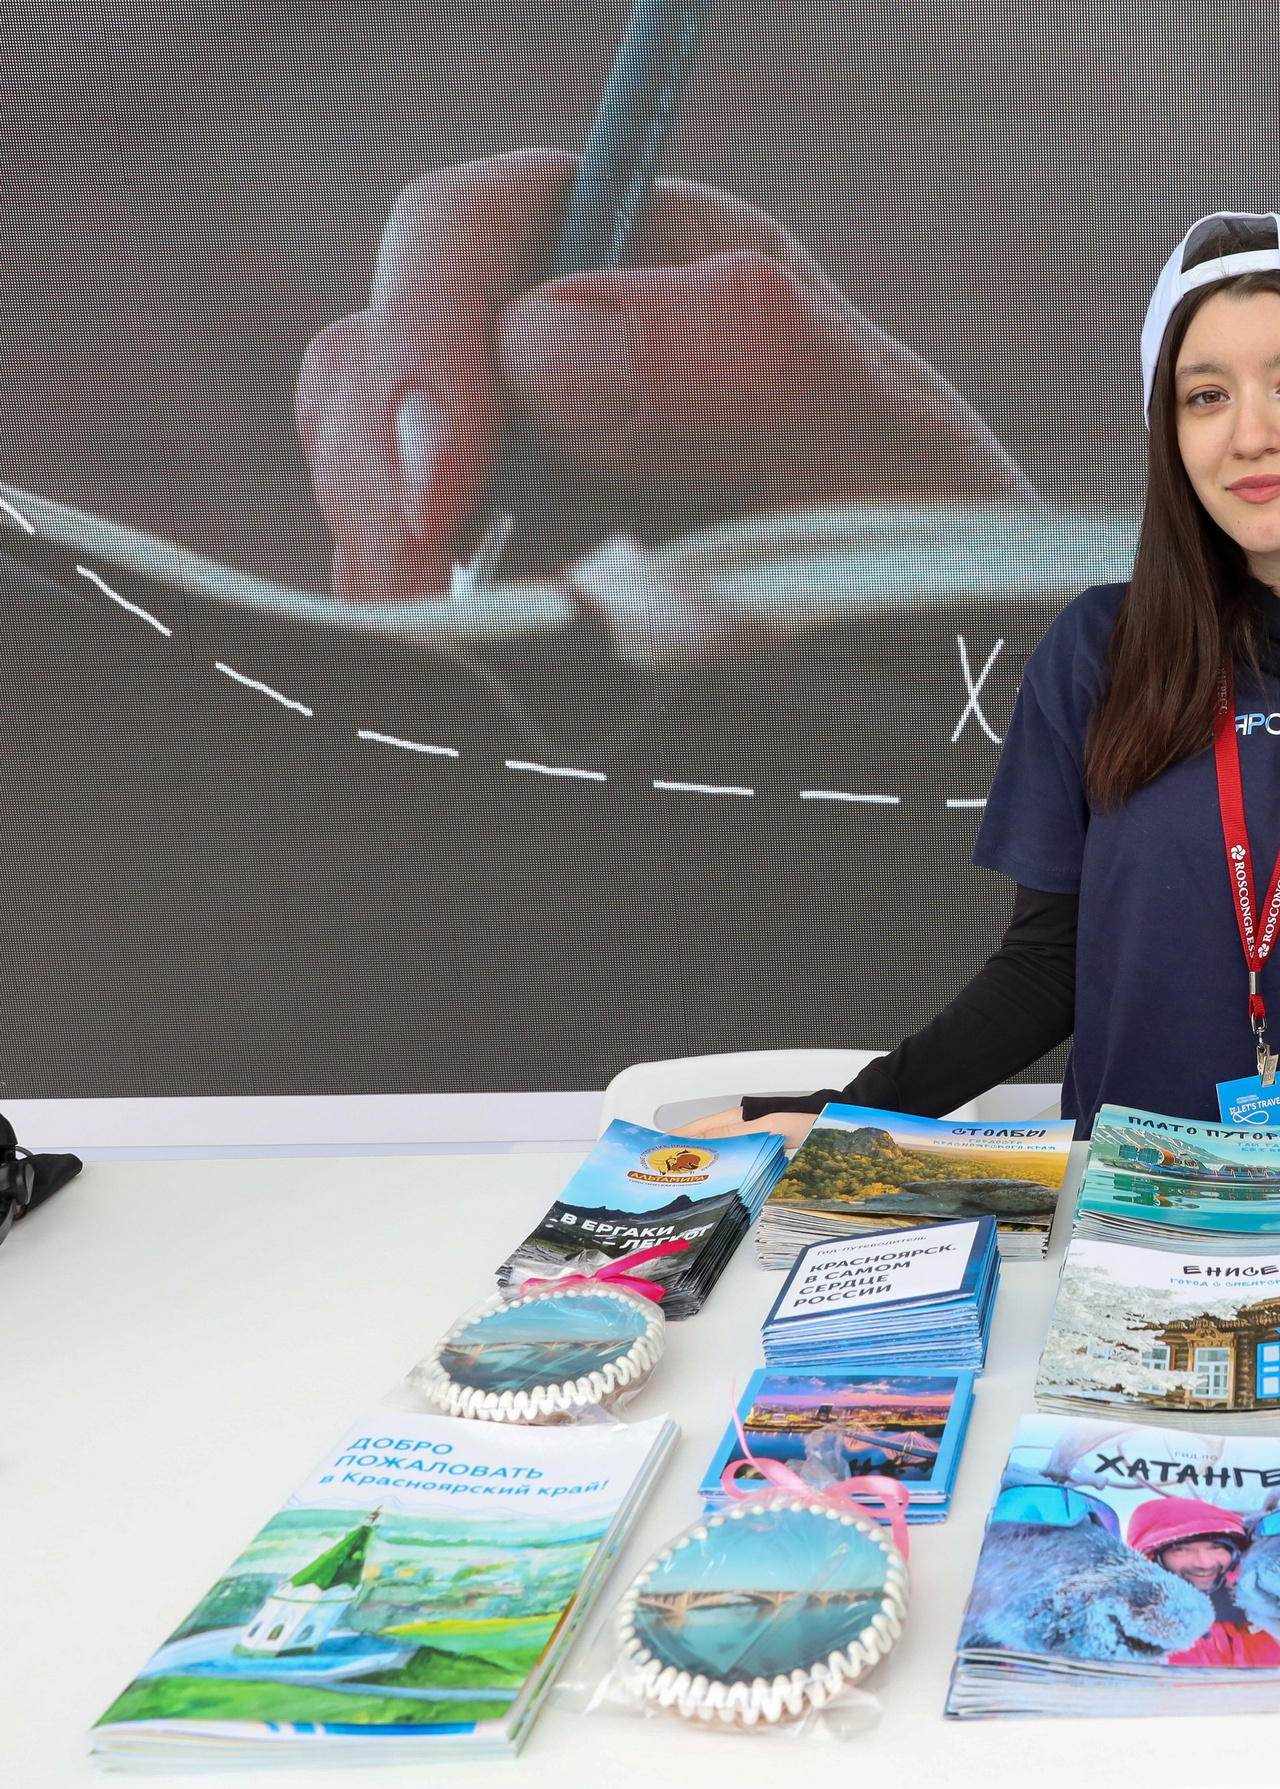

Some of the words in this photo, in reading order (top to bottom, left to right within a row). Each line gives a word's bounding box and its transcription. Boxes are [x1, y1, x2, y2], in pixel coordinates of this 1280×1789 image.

[1234, 861, 1255, 959] ROSCONGRESS
[951, 1128, 1047, 1138] СТОЛБЫ
[1128, 1116, 1198, 1135] ПЛАТО
[630, 1172, 706, 1183] АЛЬТАМИРА
[560, 1212, 578, 1225] В
[581, 1219, 676, 1237] ЕРГАКИ
[809, 1243, 957, 1273] КРАСНОЯРСК.
[804, 1275, 818, 1284] В
[824, 1261, 911, 1280] САМОМ
[1169, 1277, 1209, 1287] ГОРОД
[793, 1284, 892, 1308] РОССИИ
[799, 1274, 889, 1295] СЕРДЦЕ
[345, 1437, 453, 1455] ДОБРО
[334, 1454, 544, 1480] ПОЖАЛОВАТЬ
[319, 1474, 335, 1484] в
[340, 1471, 530, 1496] Красноярский
[537, 1479, 610, 1498] край!
